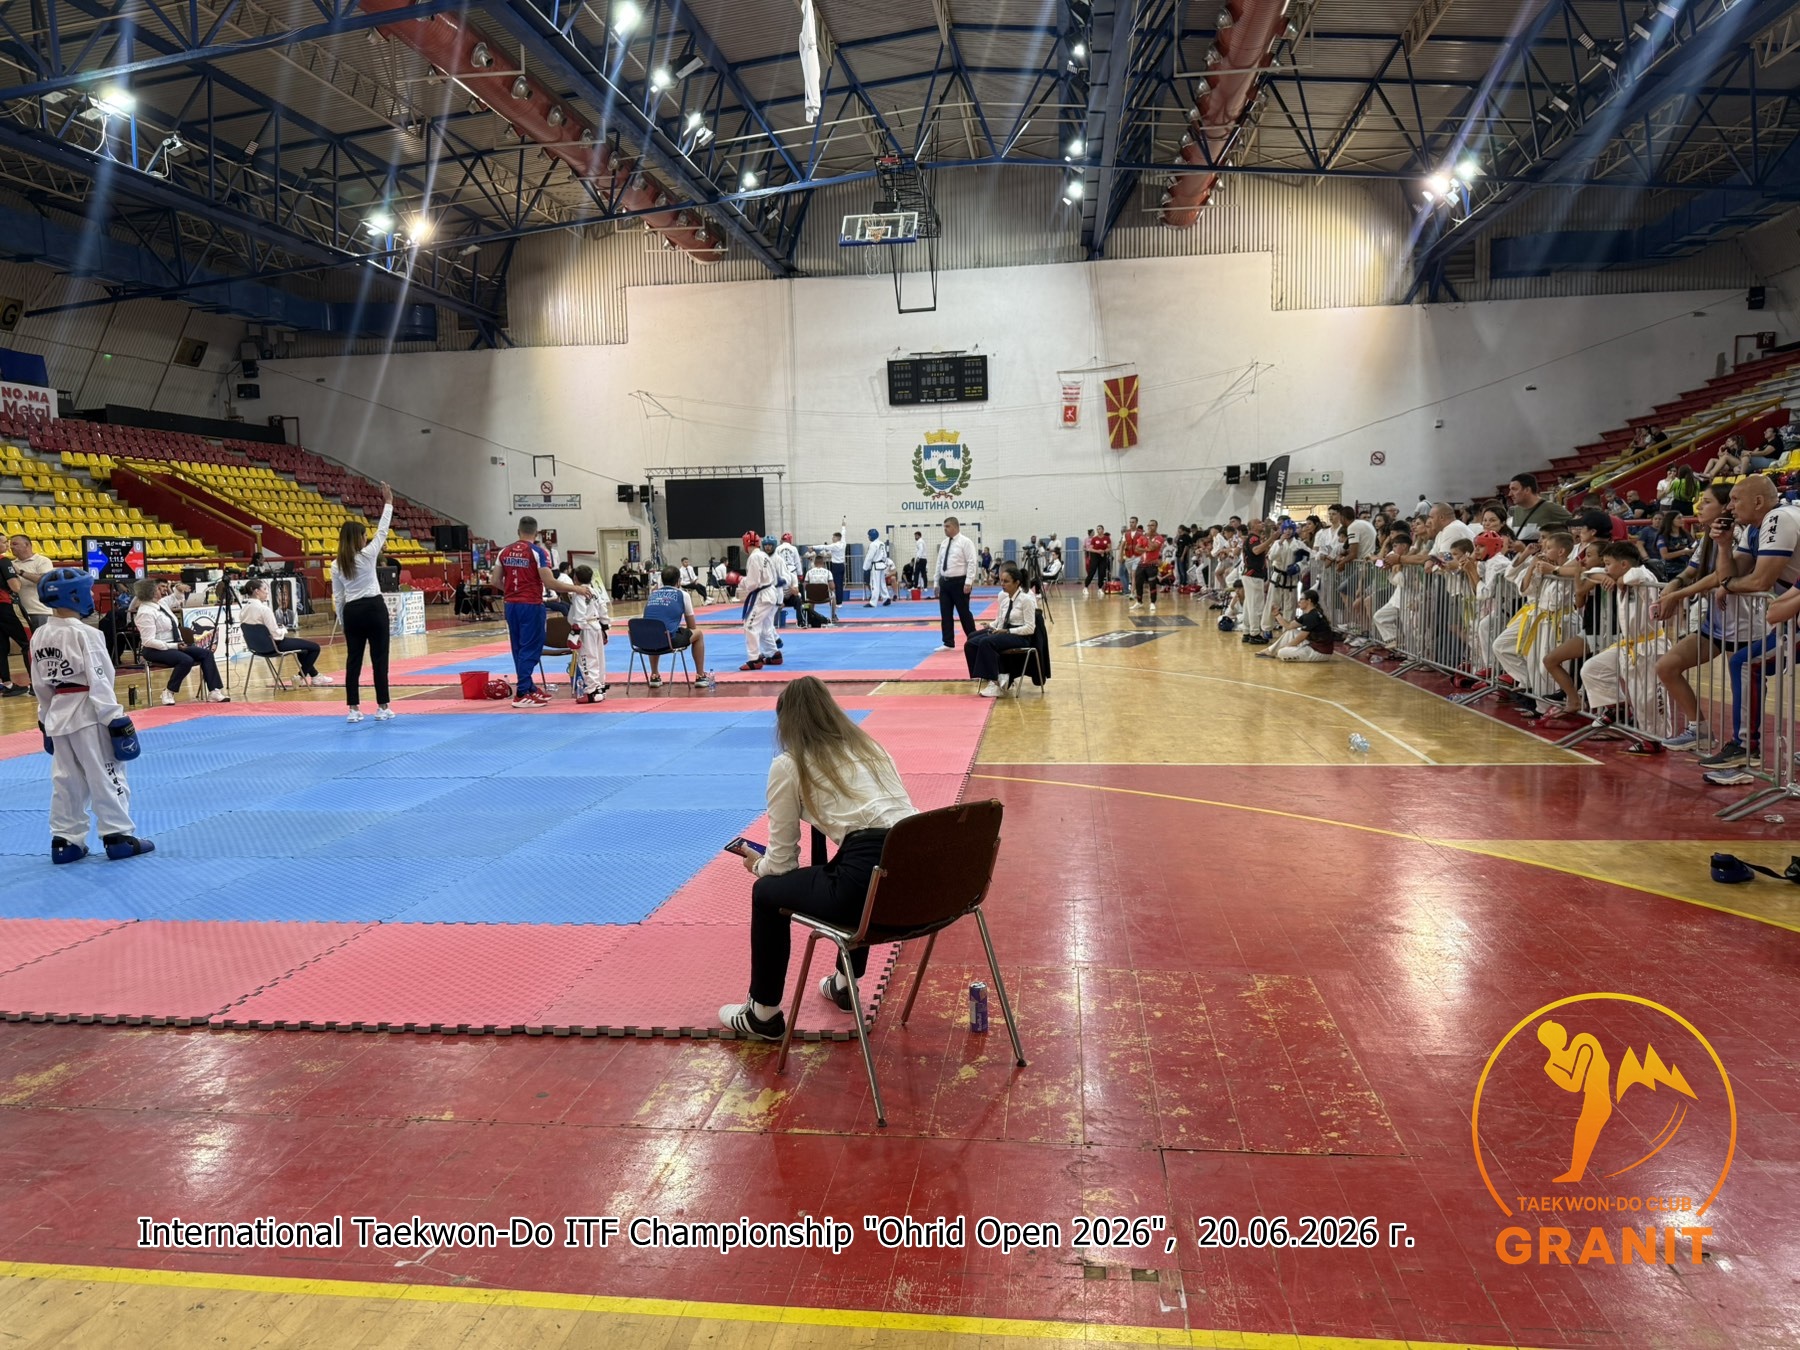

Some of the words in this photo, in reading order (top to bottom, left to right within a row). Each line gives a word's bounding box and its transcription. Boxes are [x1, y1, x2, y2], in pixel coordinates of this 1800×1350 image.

[3, 401, 50, 419] Metal
[901, 501, 949, 511] ОПШТИНА
[951, 500, 985, 511] ОХРИД
[89, 541, 95, 550] 0
[135, 542, 140, 551] 0
[137, 569, 142, 578] 0
